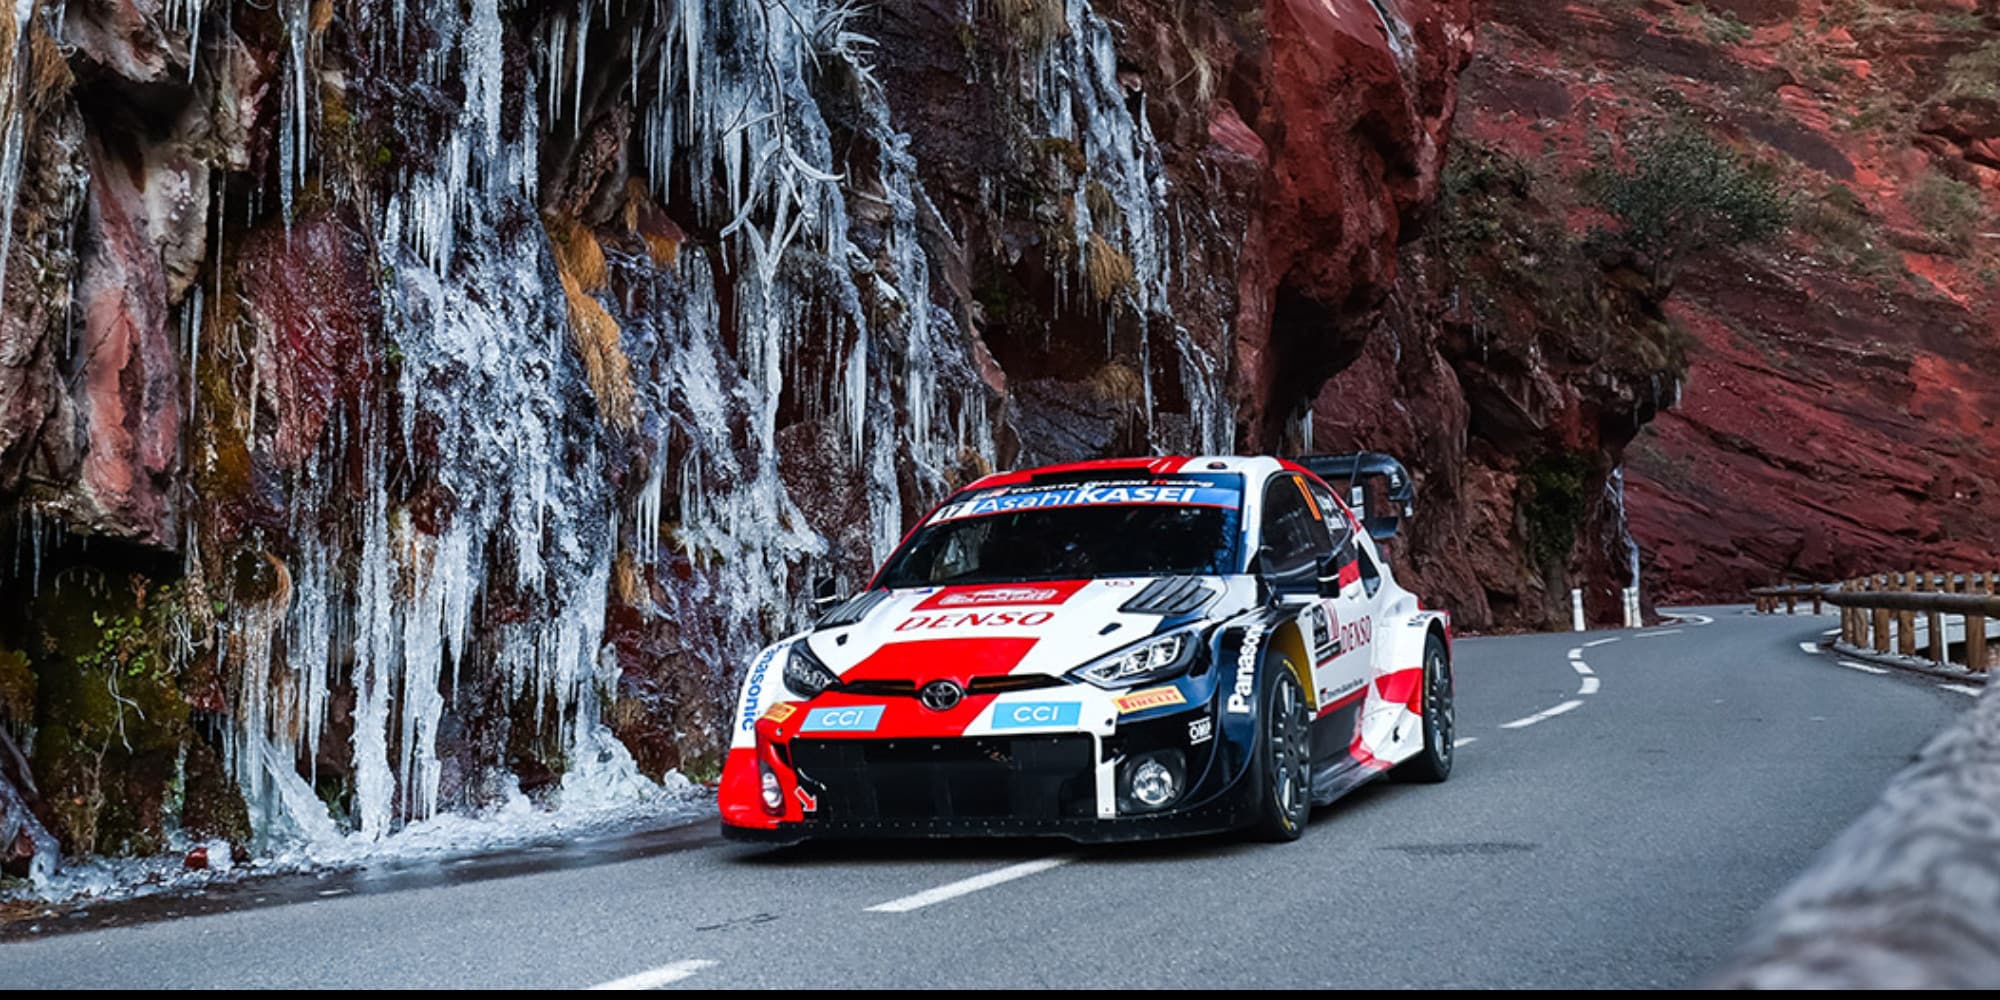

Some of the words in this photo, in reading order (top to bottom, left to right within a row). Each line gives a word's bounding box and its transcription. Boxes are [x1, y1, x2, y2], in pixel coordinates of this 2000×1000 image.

[894, 612, 1055, 632] DENSO
[1341, 615, 1372, 654] DENSO
[822, 711, 862, 727] CCI
[1013, 706, 1058, 722] CCI
